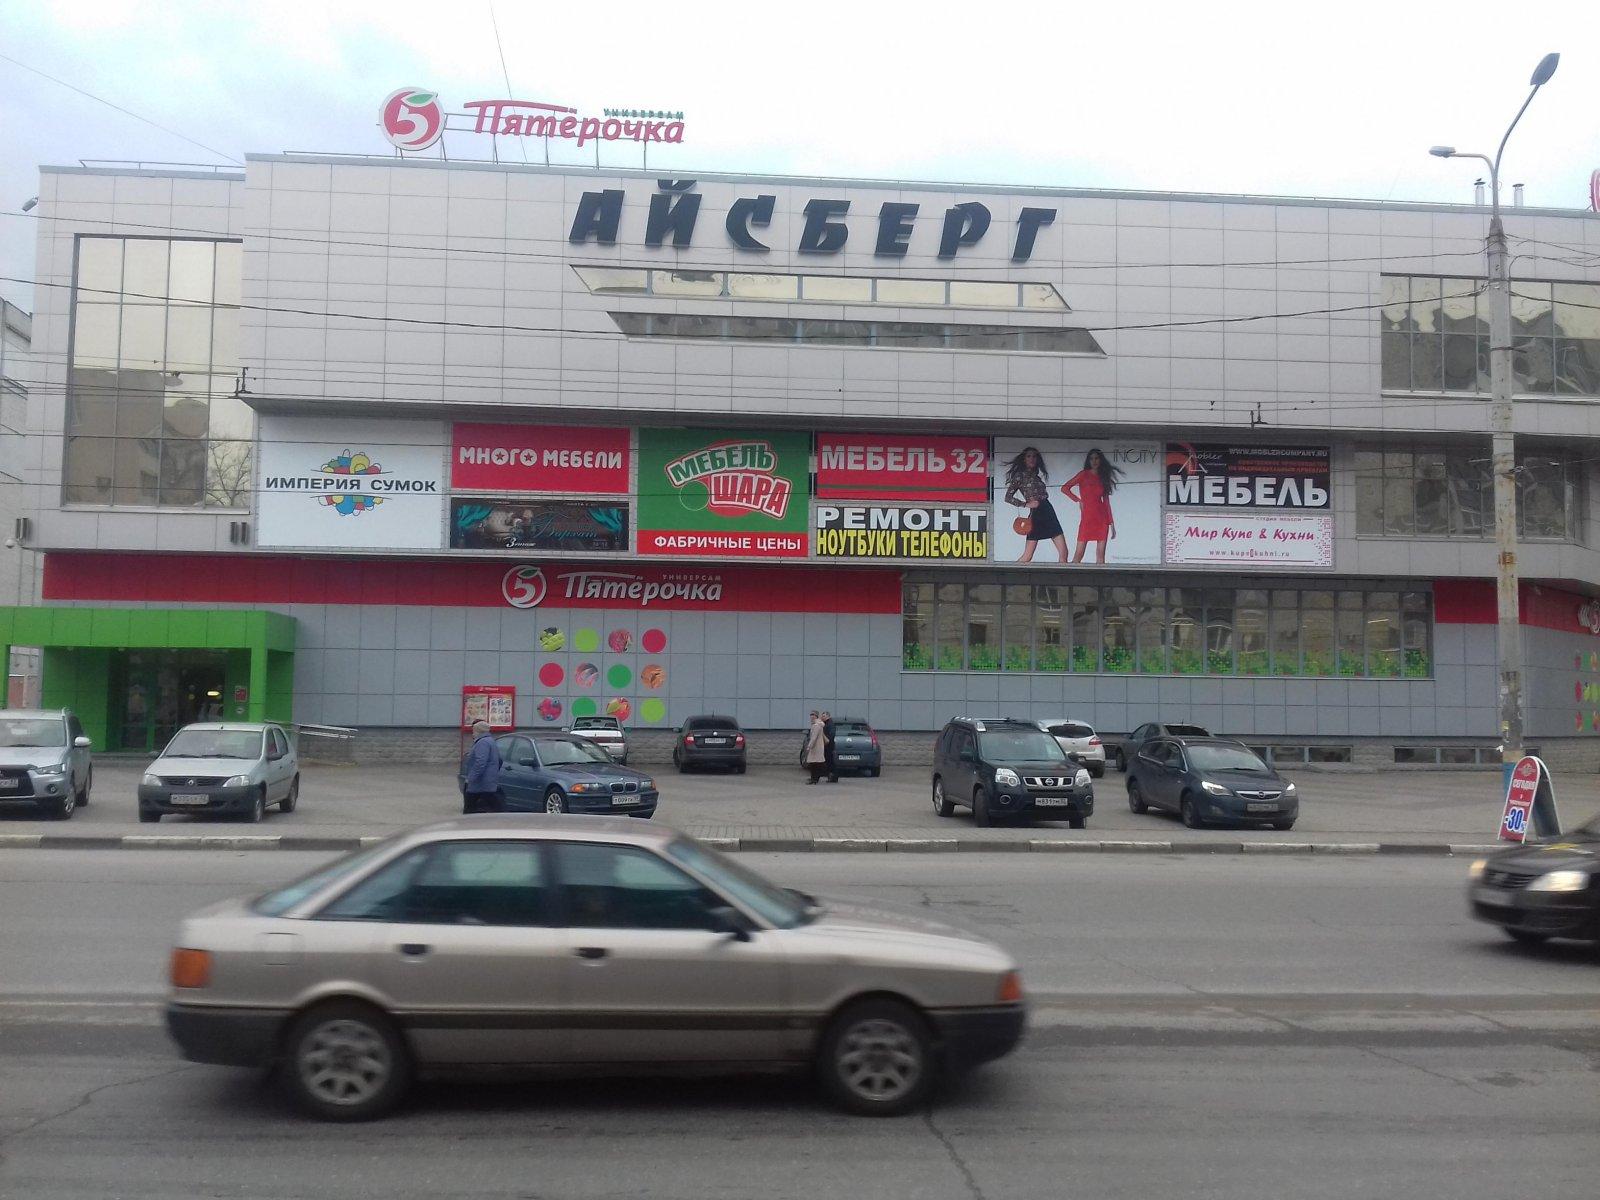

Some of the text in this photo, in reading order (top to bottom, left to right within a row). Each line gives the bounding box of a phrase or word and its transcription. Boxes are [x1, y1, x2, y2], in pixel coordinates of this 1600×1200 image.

[569, 179, 1058, 262] АЙСБЕРГ
[459, 446, 623, 469] МНОГО МЕБЕЛИ
[670, 444, 772, 483] МЕБЕЛЬ
[821, 445, 985, 474] МЕБЕЛЬ 32
[265, 477, 437, 492] ИМПЕРИЯ СУМОК
[713, 474, 789, 515] ШАРА
[1168, 474, 1328, 508] МЕБЕЛЬ
[817, 506, 987, 531] РЕМОНТ
[654, 536, 801, 551] ФАБРИЧНЫЕ ЦЕНЫ
[817, 529, 987, 558] НОУТБУКИ ТЕЛЕФОНЫ
[1184, 526, 1315, 543] Мир Купе & Кухни
[662, 573, 722, 582] УНИВЕРСАМ
